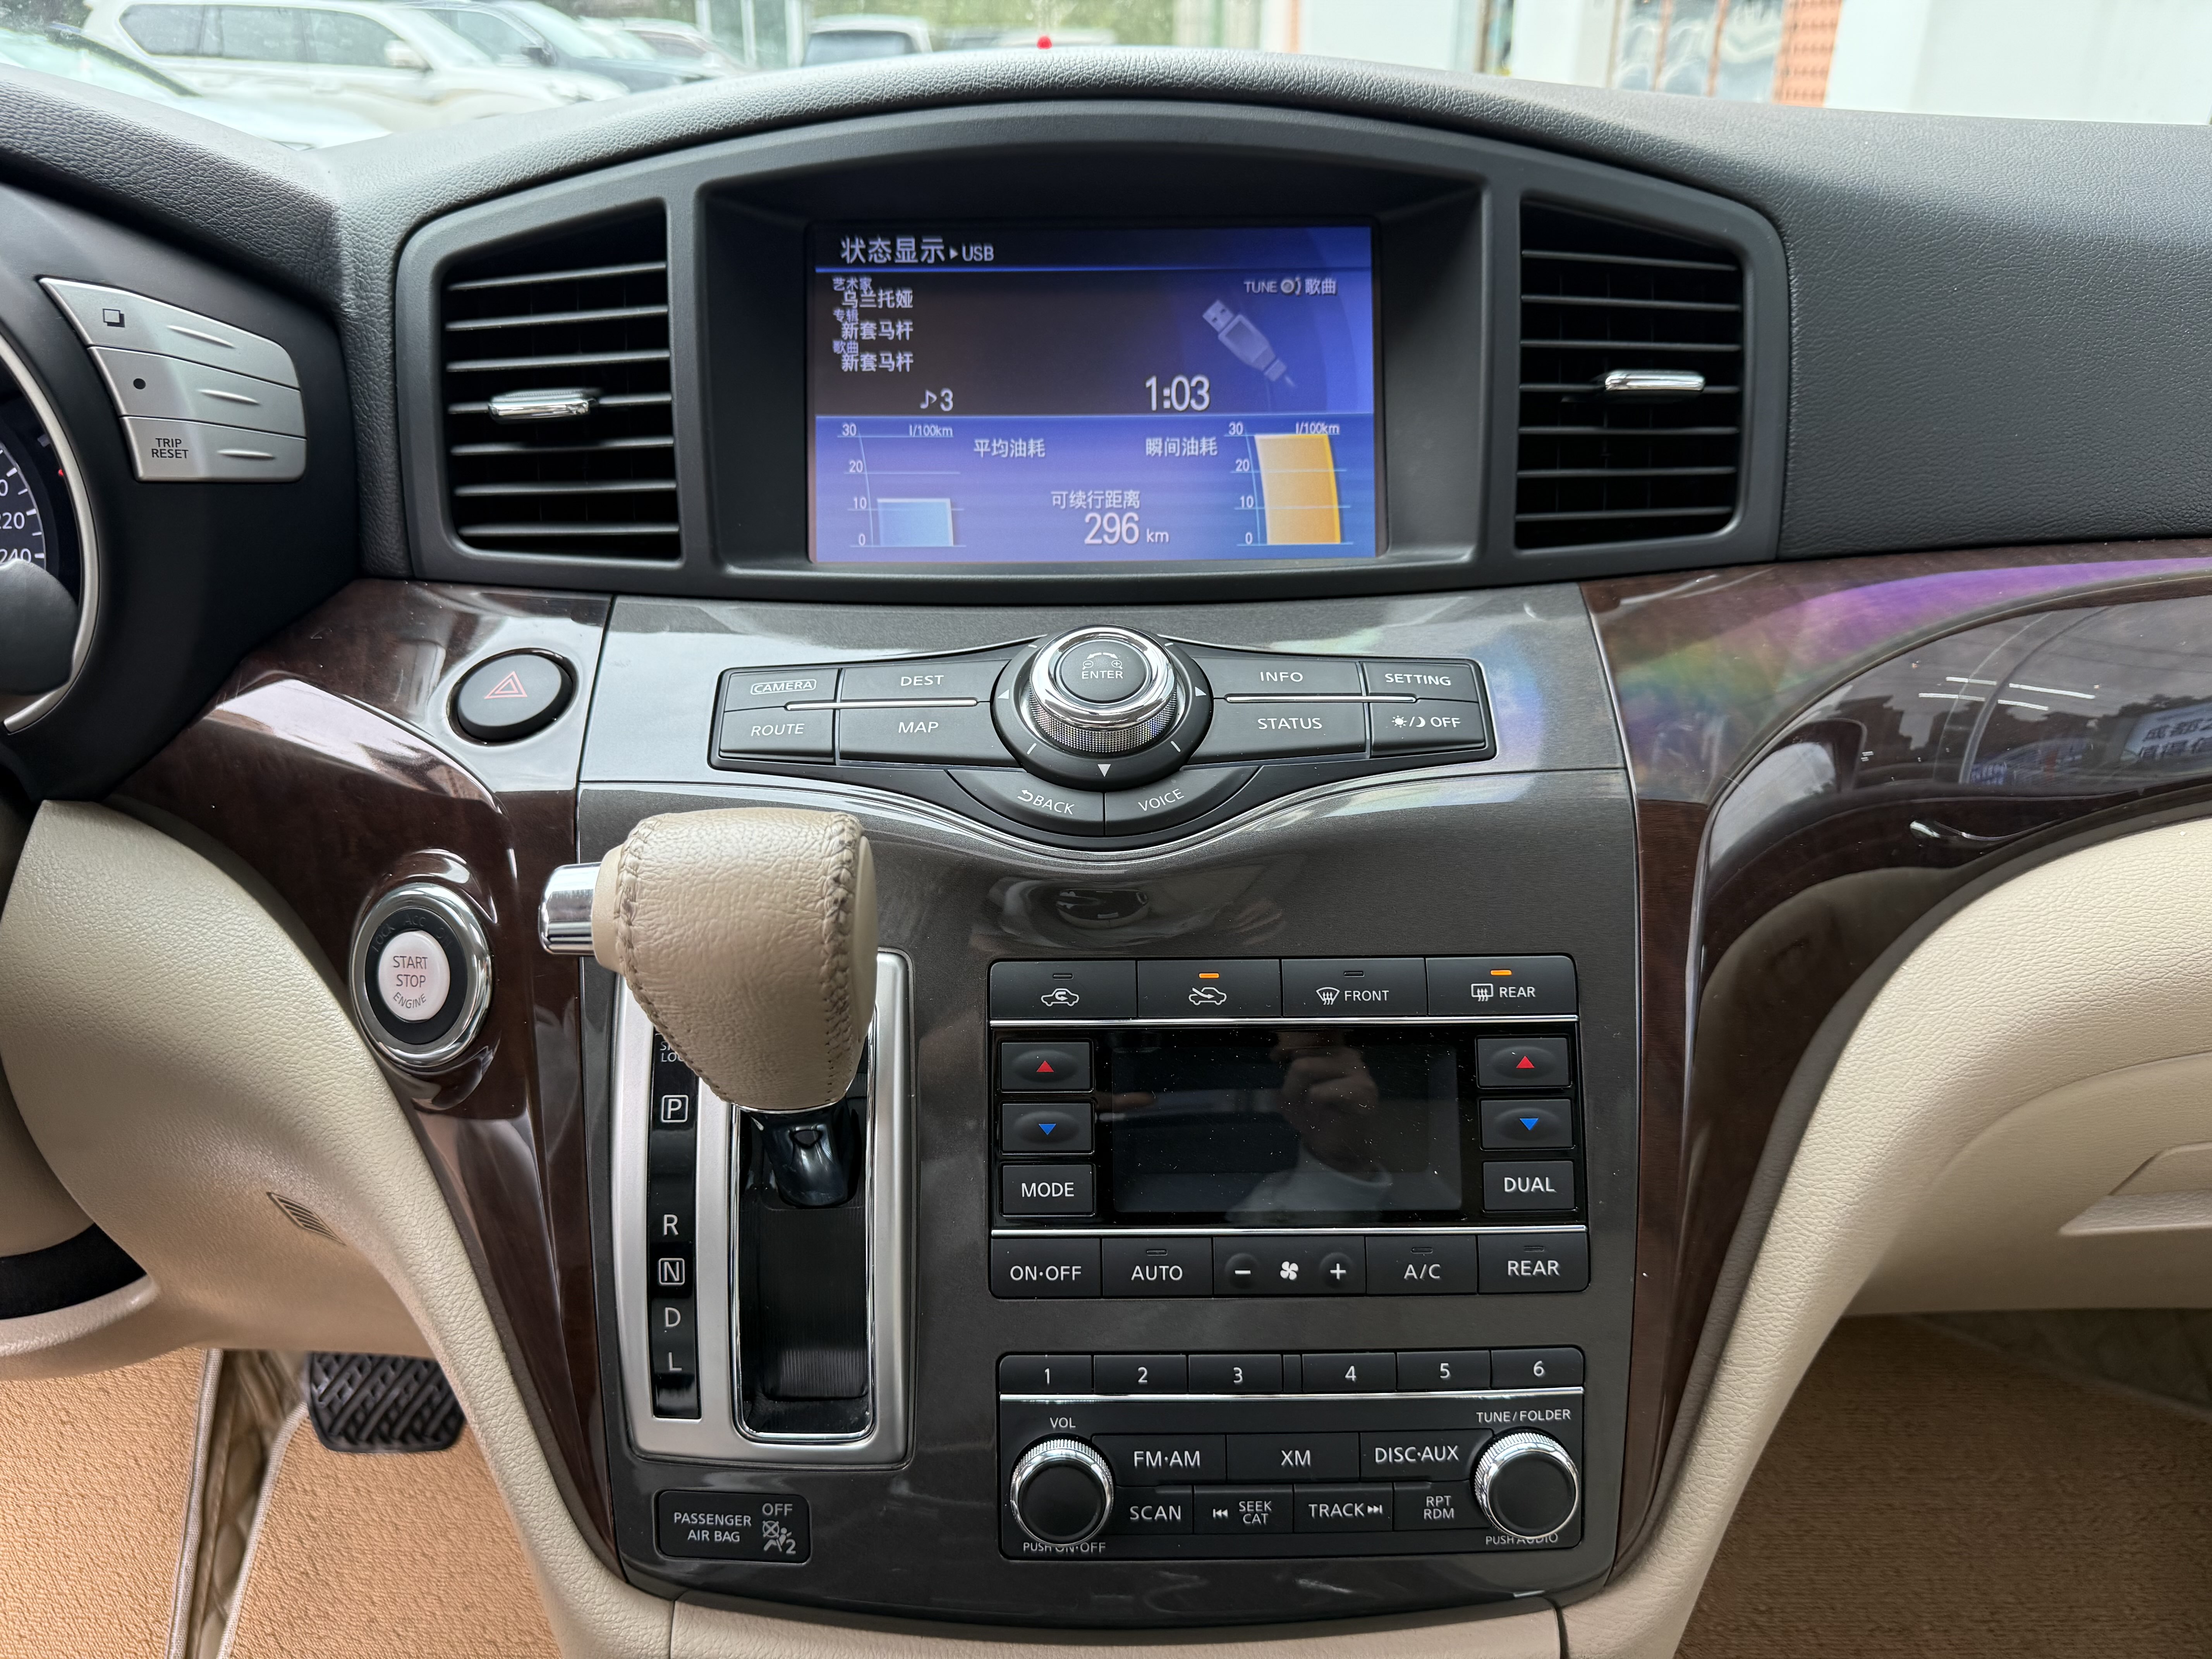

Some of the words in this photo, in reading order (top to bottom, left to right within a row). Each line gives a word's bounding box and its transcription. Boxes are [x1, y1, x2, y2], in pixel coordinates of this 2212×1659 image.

[841, 237, 945, 264] 状态显示
[962, 246, 994, 261] USB
[1244, 281, 1277, 293] TUNE
[1305, 278, 1336, 295] 歌曲
[842, 289, 913, 308] 乌兰托娅
[841, 320, 913, 340] 新套马杆
[841, 351, 914, 372] 新套马杆
[940, 389, 953, 411] 3
[1146, 375, 1209, 411] 1:03
[842, 422, 857, 436] 30
[1228, 422, 1243, 435] 30
[155, 438, 182, 448] TRIP
[974, 438, 1045, 458] 平均油耗
[1146, 436, 1218, 457] 瞬间油耗
[151, 448, 189, 459] RESET
[849, 460, 864, 473] 20
[1235, 458, 1250, 472] 20
[854, 496, 867, 510] 10
[1051, 489, 1140, 509] 可续行距离
[1240, 495, 1254, 508] 10
[1084, 512, 1139, 544] 296
[1146, 528, 1169, 543] km
[858, 533, 866, 546] 0
[1245, 532, 1253, 545] 0
[901, 675, 944, 686] DEST
[1082, 670, 1123, 679] ENTER
[1260, 672, 1303, 682] INFO
[1385, 673, 1451, 686] SETTING
[753, 680, 813, 692] CAMERA
[898, 721, 939, 733] MAP
[1257, 718, 1322, 729] STATUS
[1430, 717, 1461, 728] OFF
[750, 723, 805, 737] ROUTE
[1033, 795, 1075, 815] BACK
[1138, 788, 1185, 811] VOICE
[393, 956, 428, 969] START
[396, 974, 426, 988] STOP
[1345, 990, 1389, 1001] FRONT
[1499, 986, 1535, 998] REAR
[393, 992, 426, 1009] ENGINE
[667, 1099, 682, 1119] P
[1022, 1182, 1074, 1197] MODE
[1504, 1177, 1555, 1192] DUAL
[664, 1214, 678, 1235] R
[663, 1261, 680, 1281] N
[1131, 1265, 1183, 1280] AUTO
[1404, 1264, 1440, 1279] A/C
[1508, 1260, 1559, 1276] REAR
[665, 1307, 681, 1327] D
[669, 1352, 682, 1371] L
[1534, 1360, 1544, 1377] 6
[1045, 1368, 1049, 1384] 1
[1138, 1367, 1147, 1383] 2
[1233, 1367, 1243, 1383] 3
[1345, 1365, 1356, 1381] 4
[1440, 1363, 1450, 1378] 5
[1050, 1417, 1076, 1429] VOL
[1281, 1450, 1310, 1466] XM
[1239, 1501, 1272, 1511] SEEK
[1426, 1496, 1451, 1506] RPT
[762, 1503, 793, 1516] OFF
[1130, 1505, 1181, 1520] SCAN
[1308, 1503, 1364, 1517] TRACK
[1424, 1508, 1454, 1519] RDM
[674, 1512, 751, 1526] PASSENGER
[1243, 1513, 1268, 1524] CAT
[687, 1529, 710, 1541] AIR
[714, 1530, 740, 1542] BAG
[1486, 1535, 1514, 1545] PUSH
[1023, 1542, 1052, 1552] PUSH
